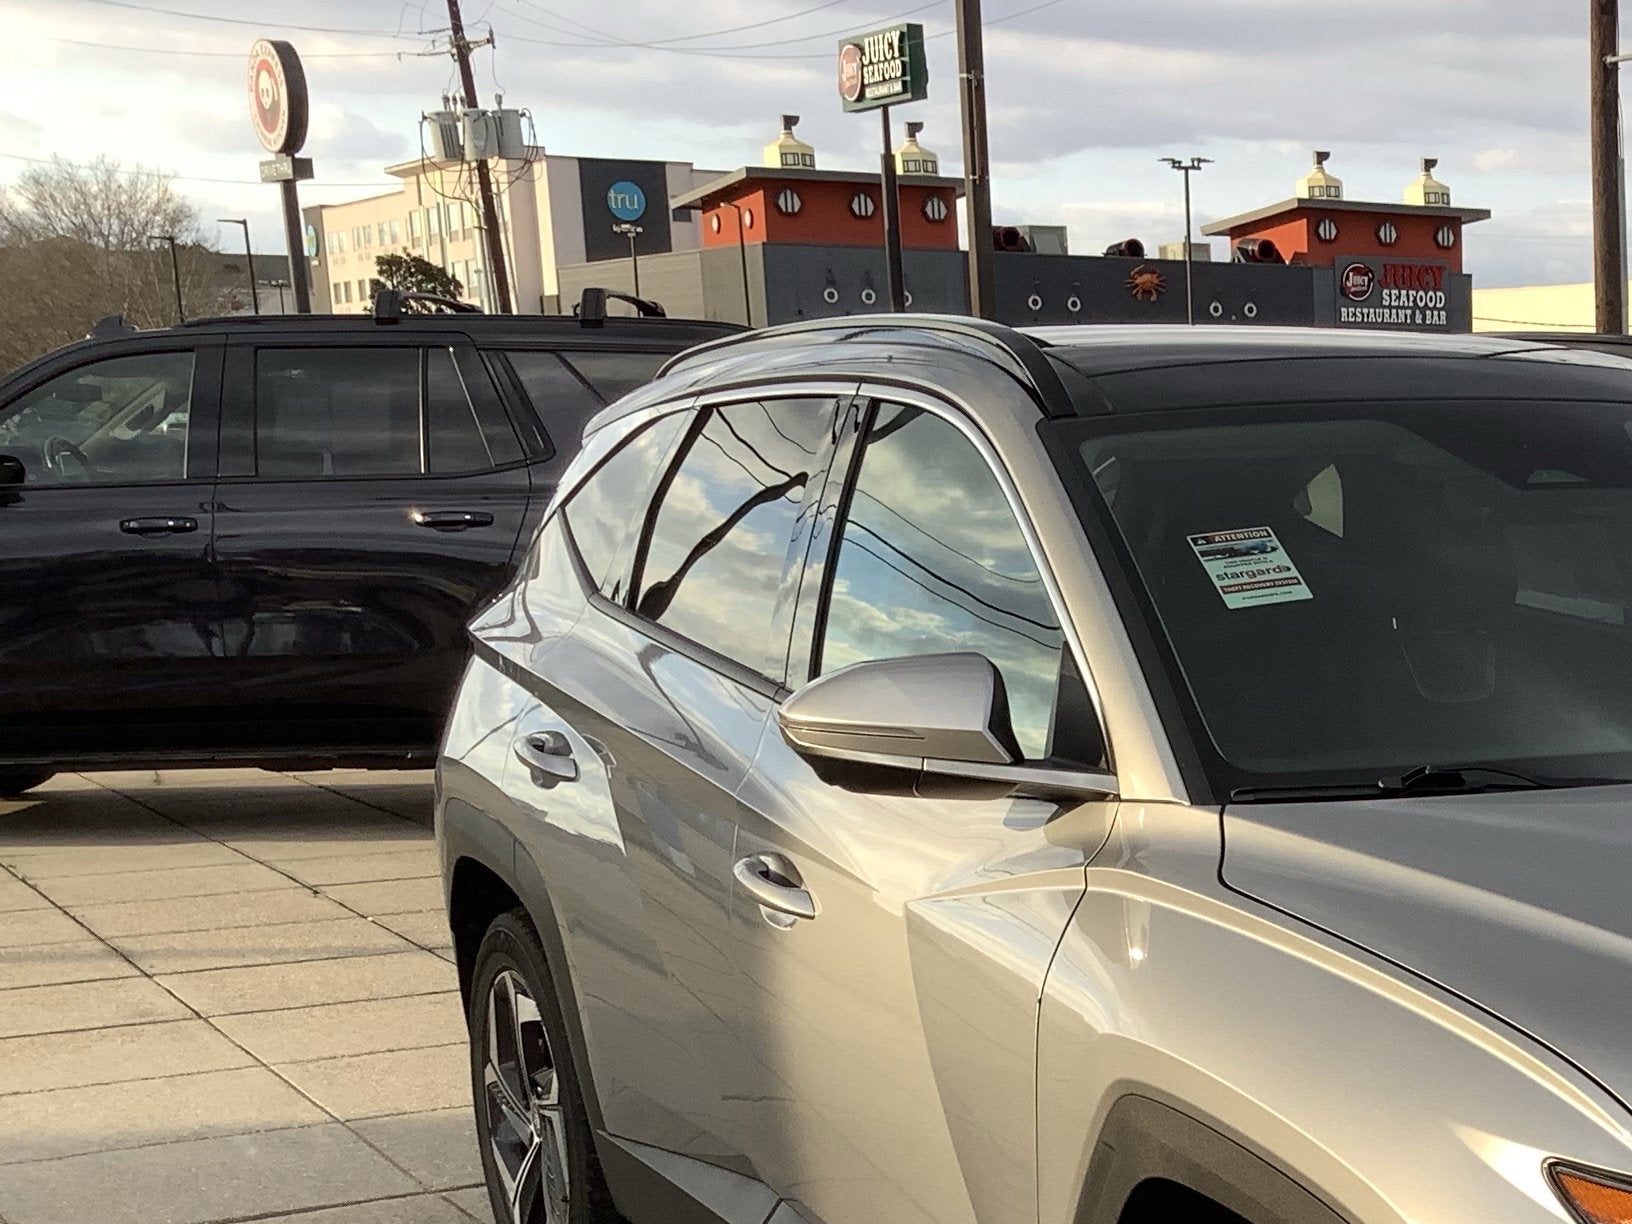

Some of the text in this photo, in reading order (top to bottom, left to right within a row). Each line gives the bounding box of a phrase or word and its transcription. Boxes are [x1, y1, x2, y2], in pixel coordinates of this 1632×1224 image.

[862, 30, 900, 65] JUICY
[863, 59, 902, 85] SEAFOOD
[608, 189, 639, 209] tru
[1378, 263, 1446, 290] JUICY
[1382, 289, 1446, 308] SEAFOOD
[1341, 307, 1447, 325] RESTAURANT & BAR
[1214, 530, 1268, 542] ATTENTION
[1244, 581, 1274, 590] RECOVERY
[1275, 578, 1299, 586] SYSTEM
